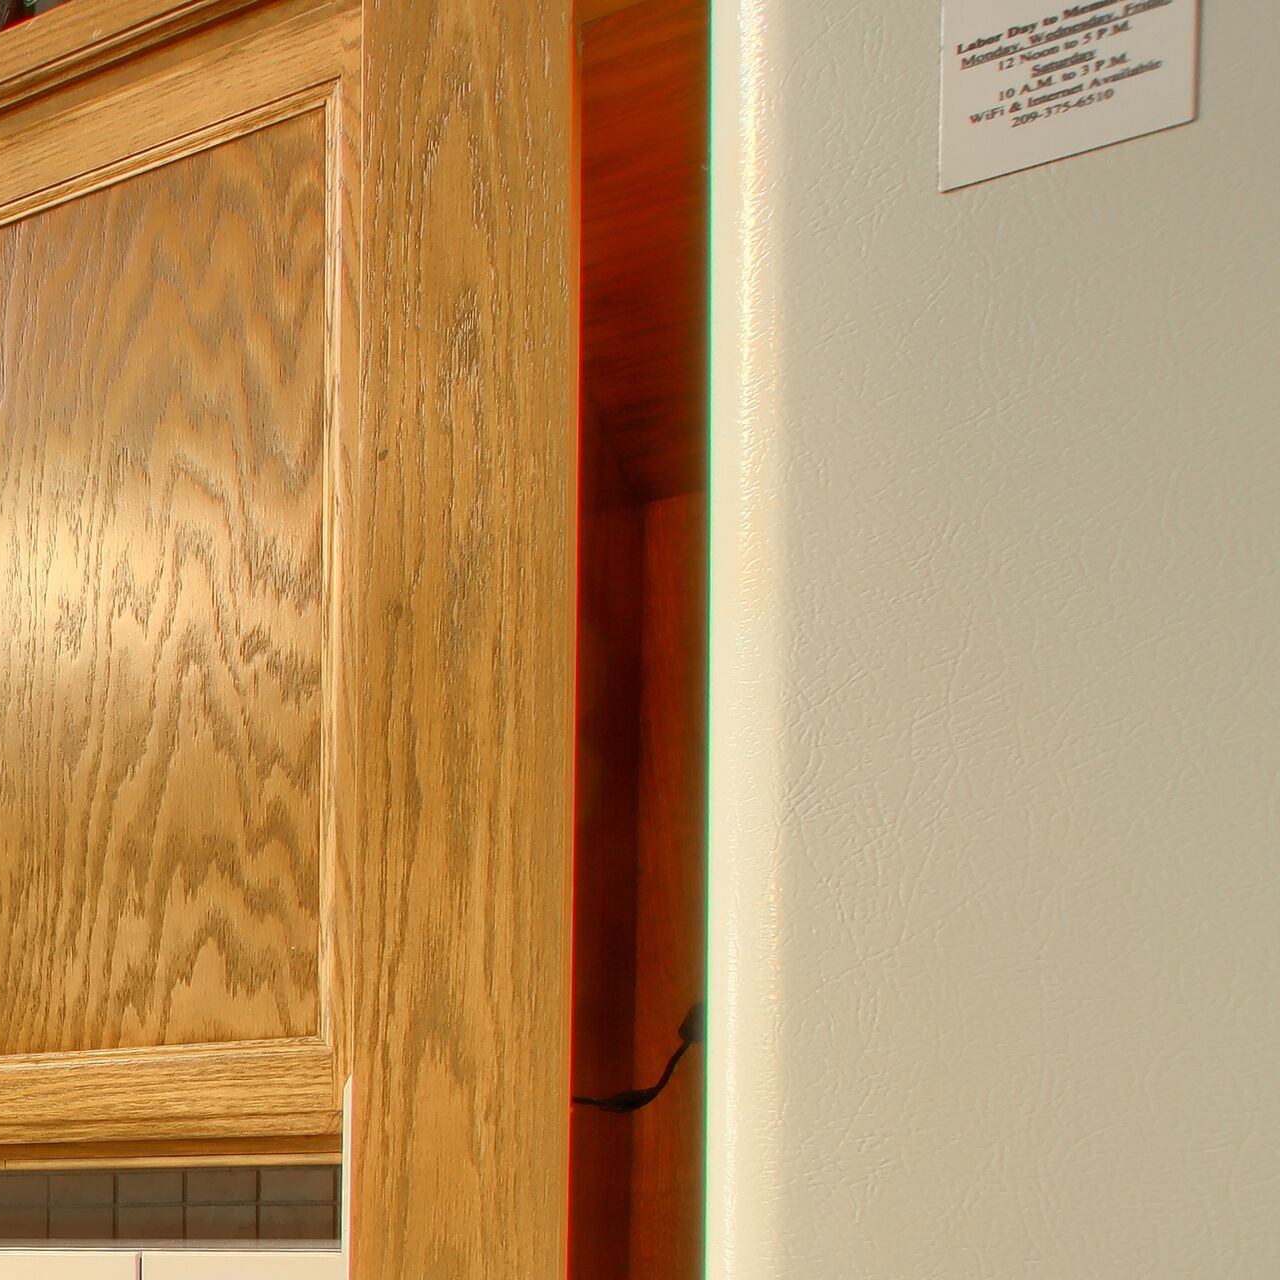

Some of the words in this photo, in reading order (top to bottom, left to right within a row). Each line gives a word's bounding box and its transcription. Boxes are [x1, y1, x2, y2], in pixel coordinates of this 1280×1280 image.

[956, 33, 1003, 55] Labor
[1007, 22, 1038, 39] Day
[1043, 16, 1058, 26] to
[999, 57, 1015, 71] 12
[1019, 46, 1059, 64] Noon
[1064, 39, 1078, 49] to
[1082, 32, 1092, 45] 5
[999, 88, 1015, 101] 10
[1062, 71, 1076, 82] to
[1081, 64, 1089, 76] 3
[1031, 49, 1097, 78] Saturday
[969, 105, 1005, 123] WiFi
[1009, 101, 1021, 113] &
[1028, 83, 1083, 107] Internet
[1088, 60, 1163, 90] Available
[1011, 88, 1115, 128] 209-375-6510
